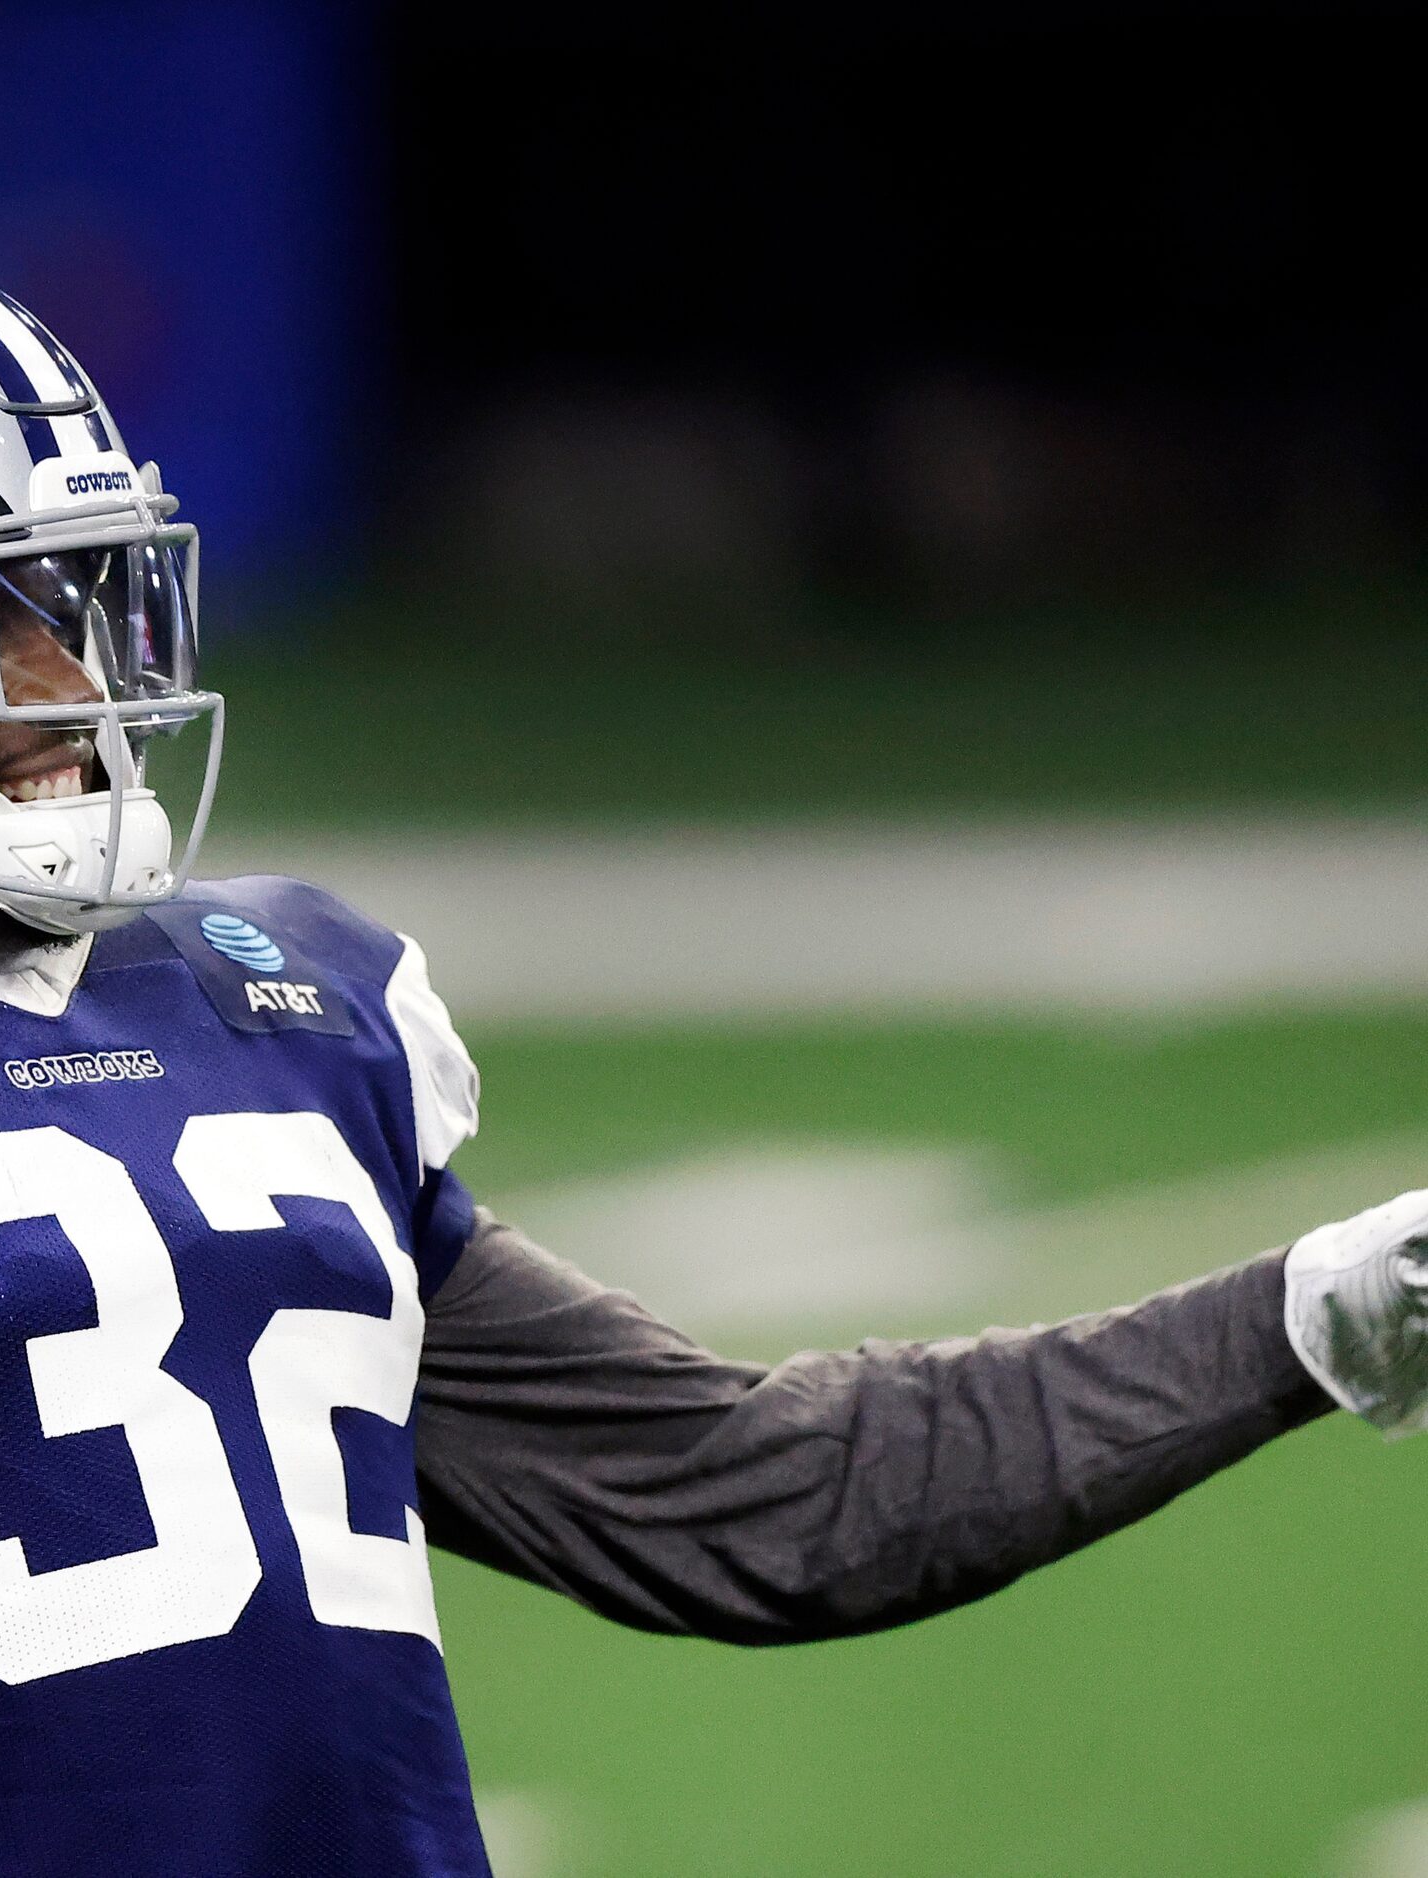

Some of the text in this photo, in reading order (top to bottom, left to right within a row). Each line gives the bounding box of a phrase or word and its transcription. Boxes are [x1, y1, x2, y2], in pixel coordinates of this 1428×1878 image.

[66, 472, 132, 495] COWBOYS
[244, 981, 324, 1015] AT&T
[4, 1050, 165, 1090] COWBOYS
